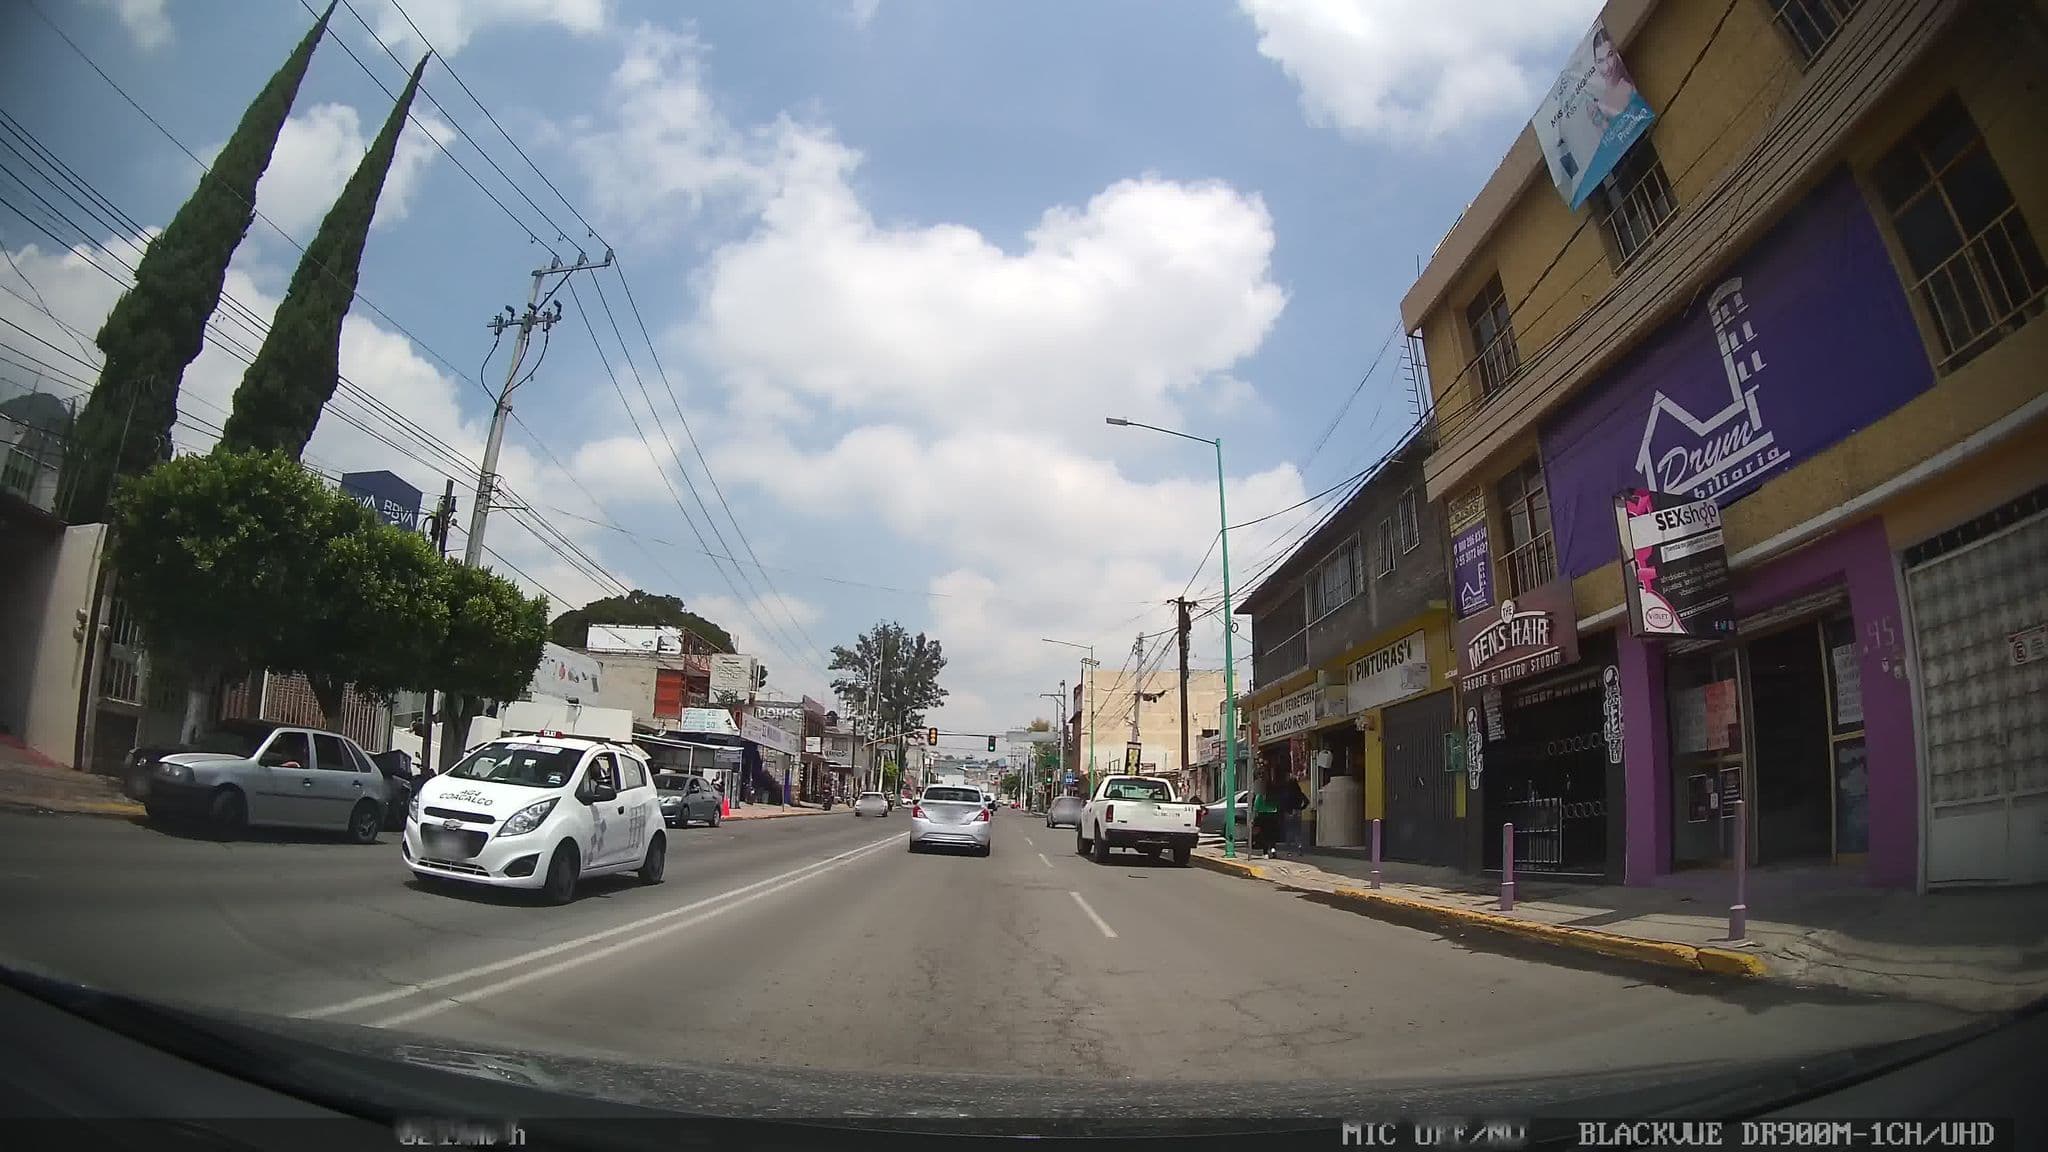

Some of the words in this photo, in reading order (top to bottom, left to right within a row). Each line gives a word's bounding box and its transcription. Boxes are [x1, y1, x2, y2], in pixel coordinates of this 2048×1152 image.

[1693, 447, 1780, 499] biliaria
[383, 499, 414, 528] BBVA
[1468, 624, 1507, 671] MEN'S
[1511, 618, 1549, 647] HAIR
[1500, 663, 1527, 681] TATTOO
[1530, 651, 1560, 672] STUDIO
[1272, 716, 1292, 734] CONGO
[439, 792, 494, 807] COACALCO
